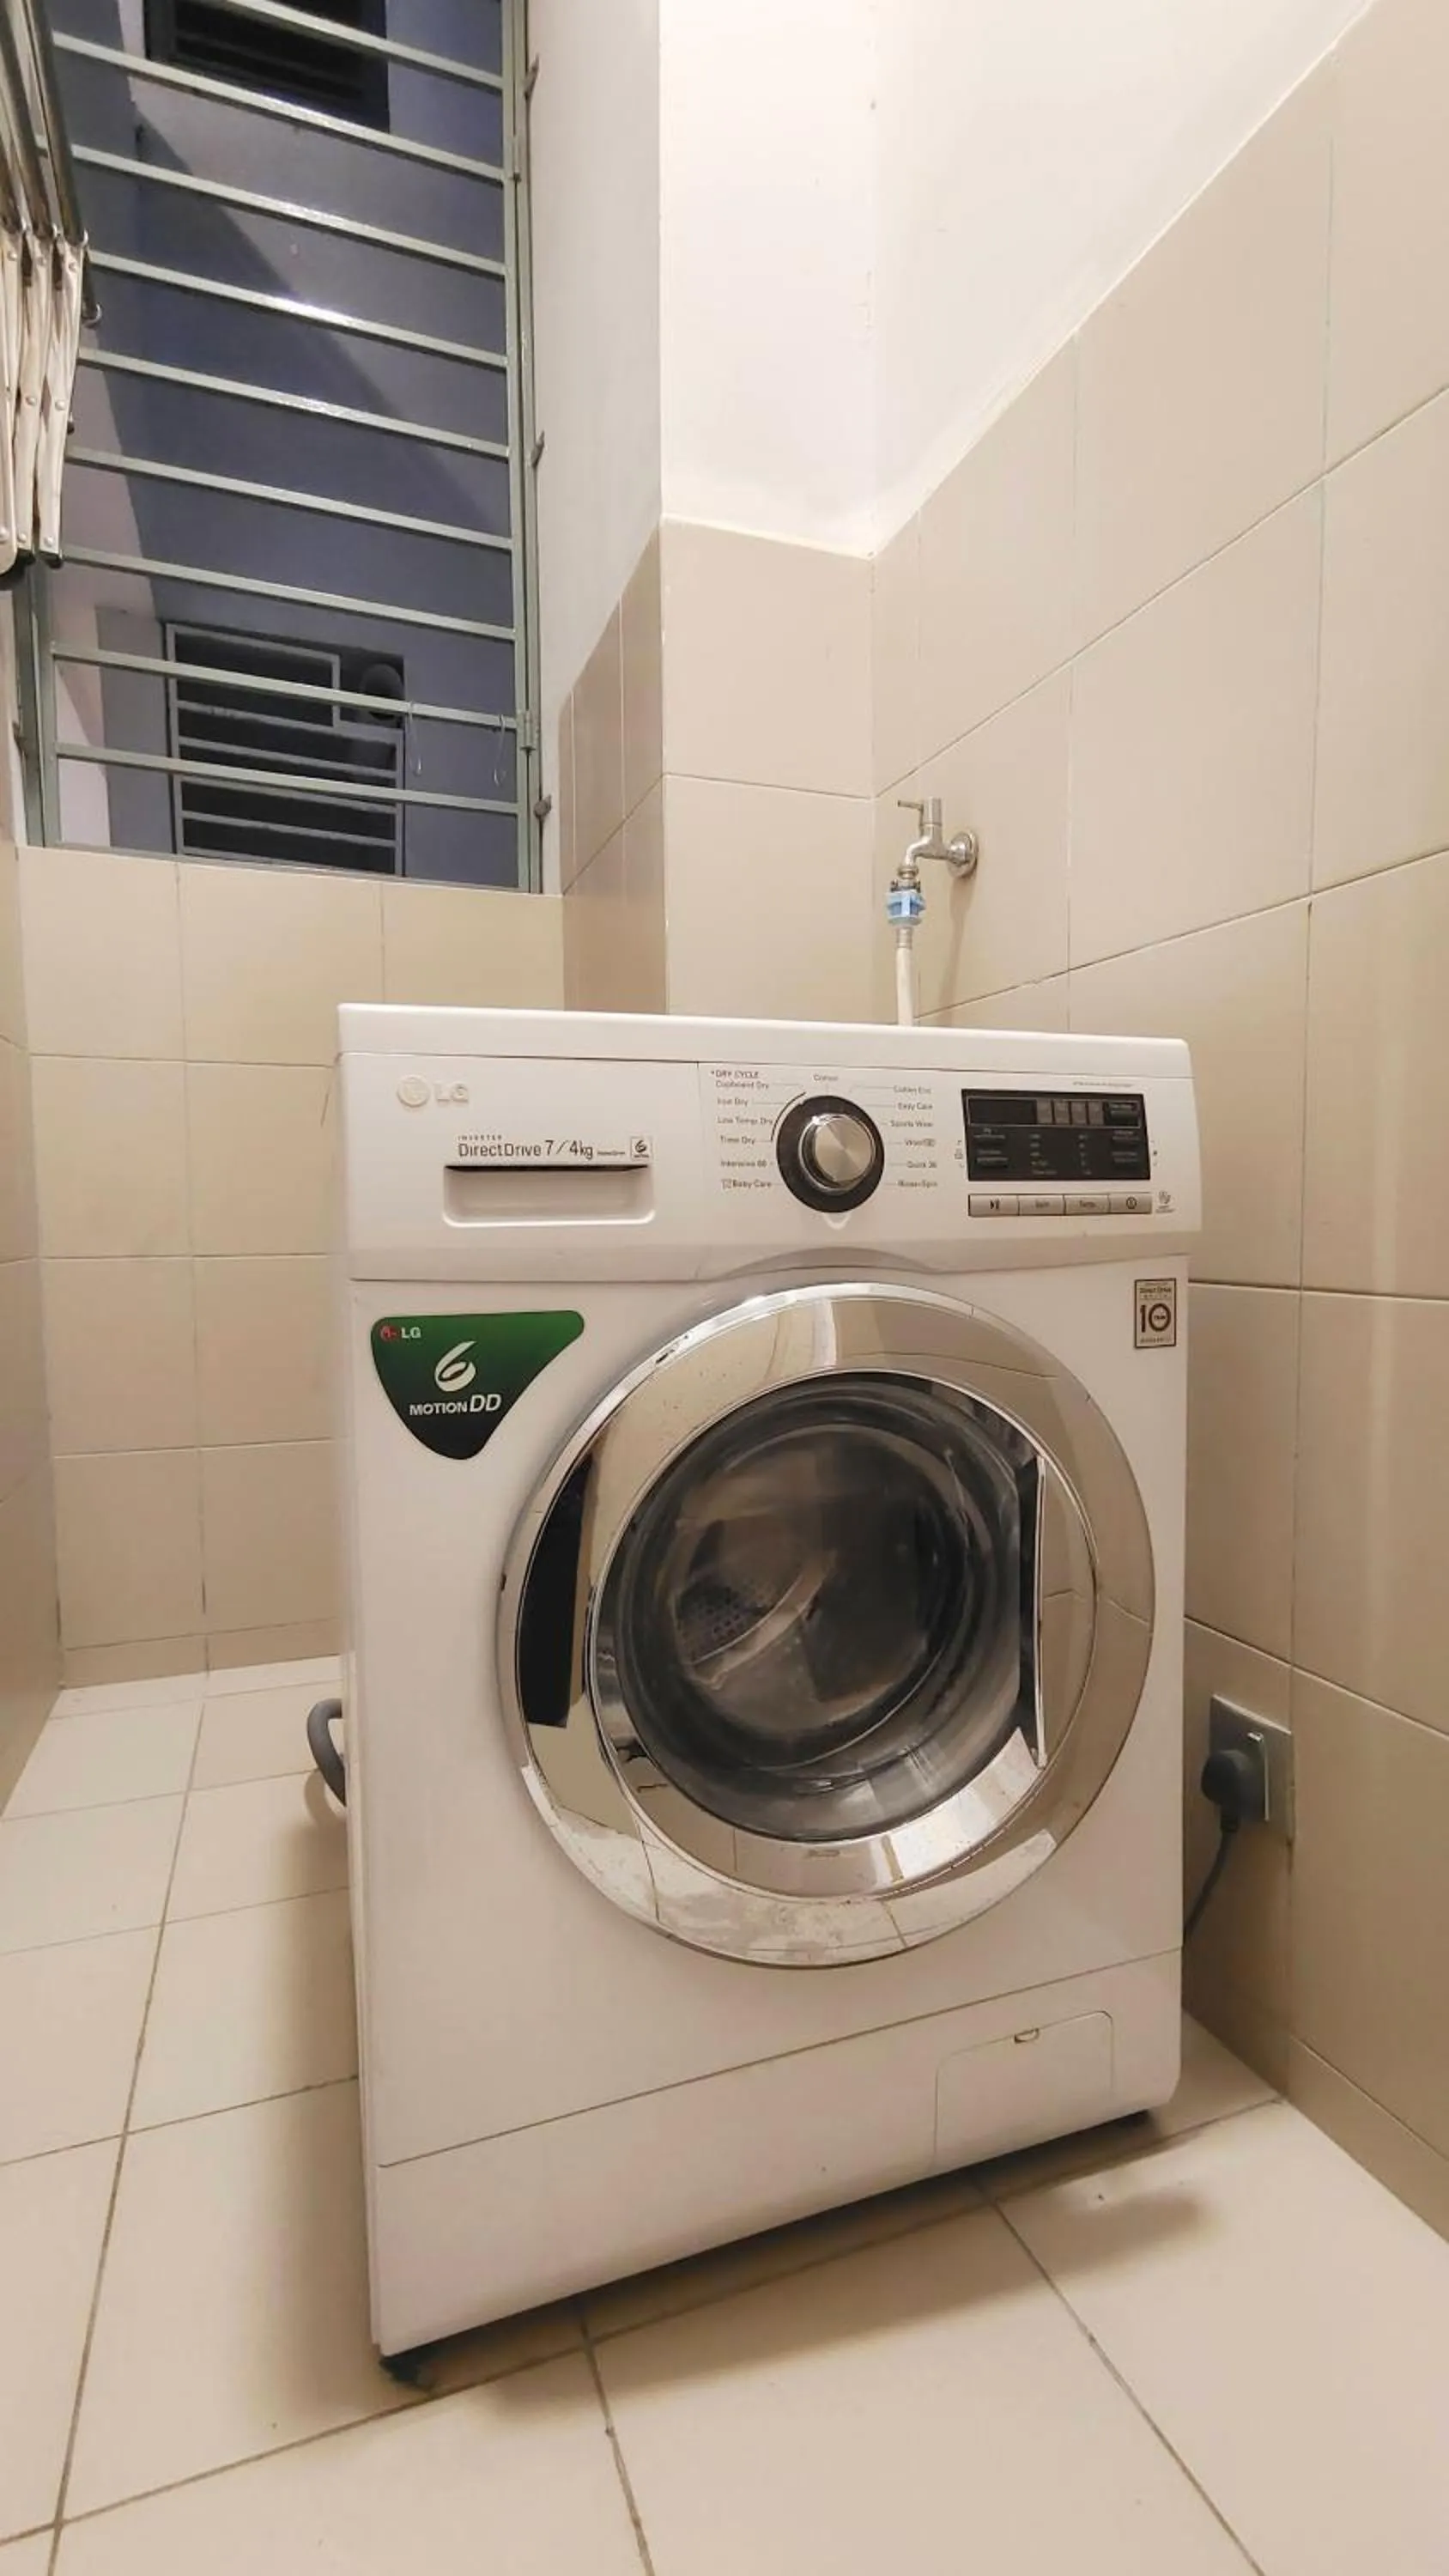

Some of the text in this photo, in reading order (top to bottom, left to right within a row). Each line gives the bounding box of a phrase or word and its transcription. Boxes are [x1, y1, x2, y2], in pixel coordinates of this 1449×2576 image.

[735, 1097, 749, 1108] Dry
[720, 1134, 756, 1145] Time Dry
[754, 1178, 772, 1188] Care
[1140, 1303, 1171, 1333] 10
[402, 1327, 421, 1339] LG
[433, 1340, 477, 1392] 6
